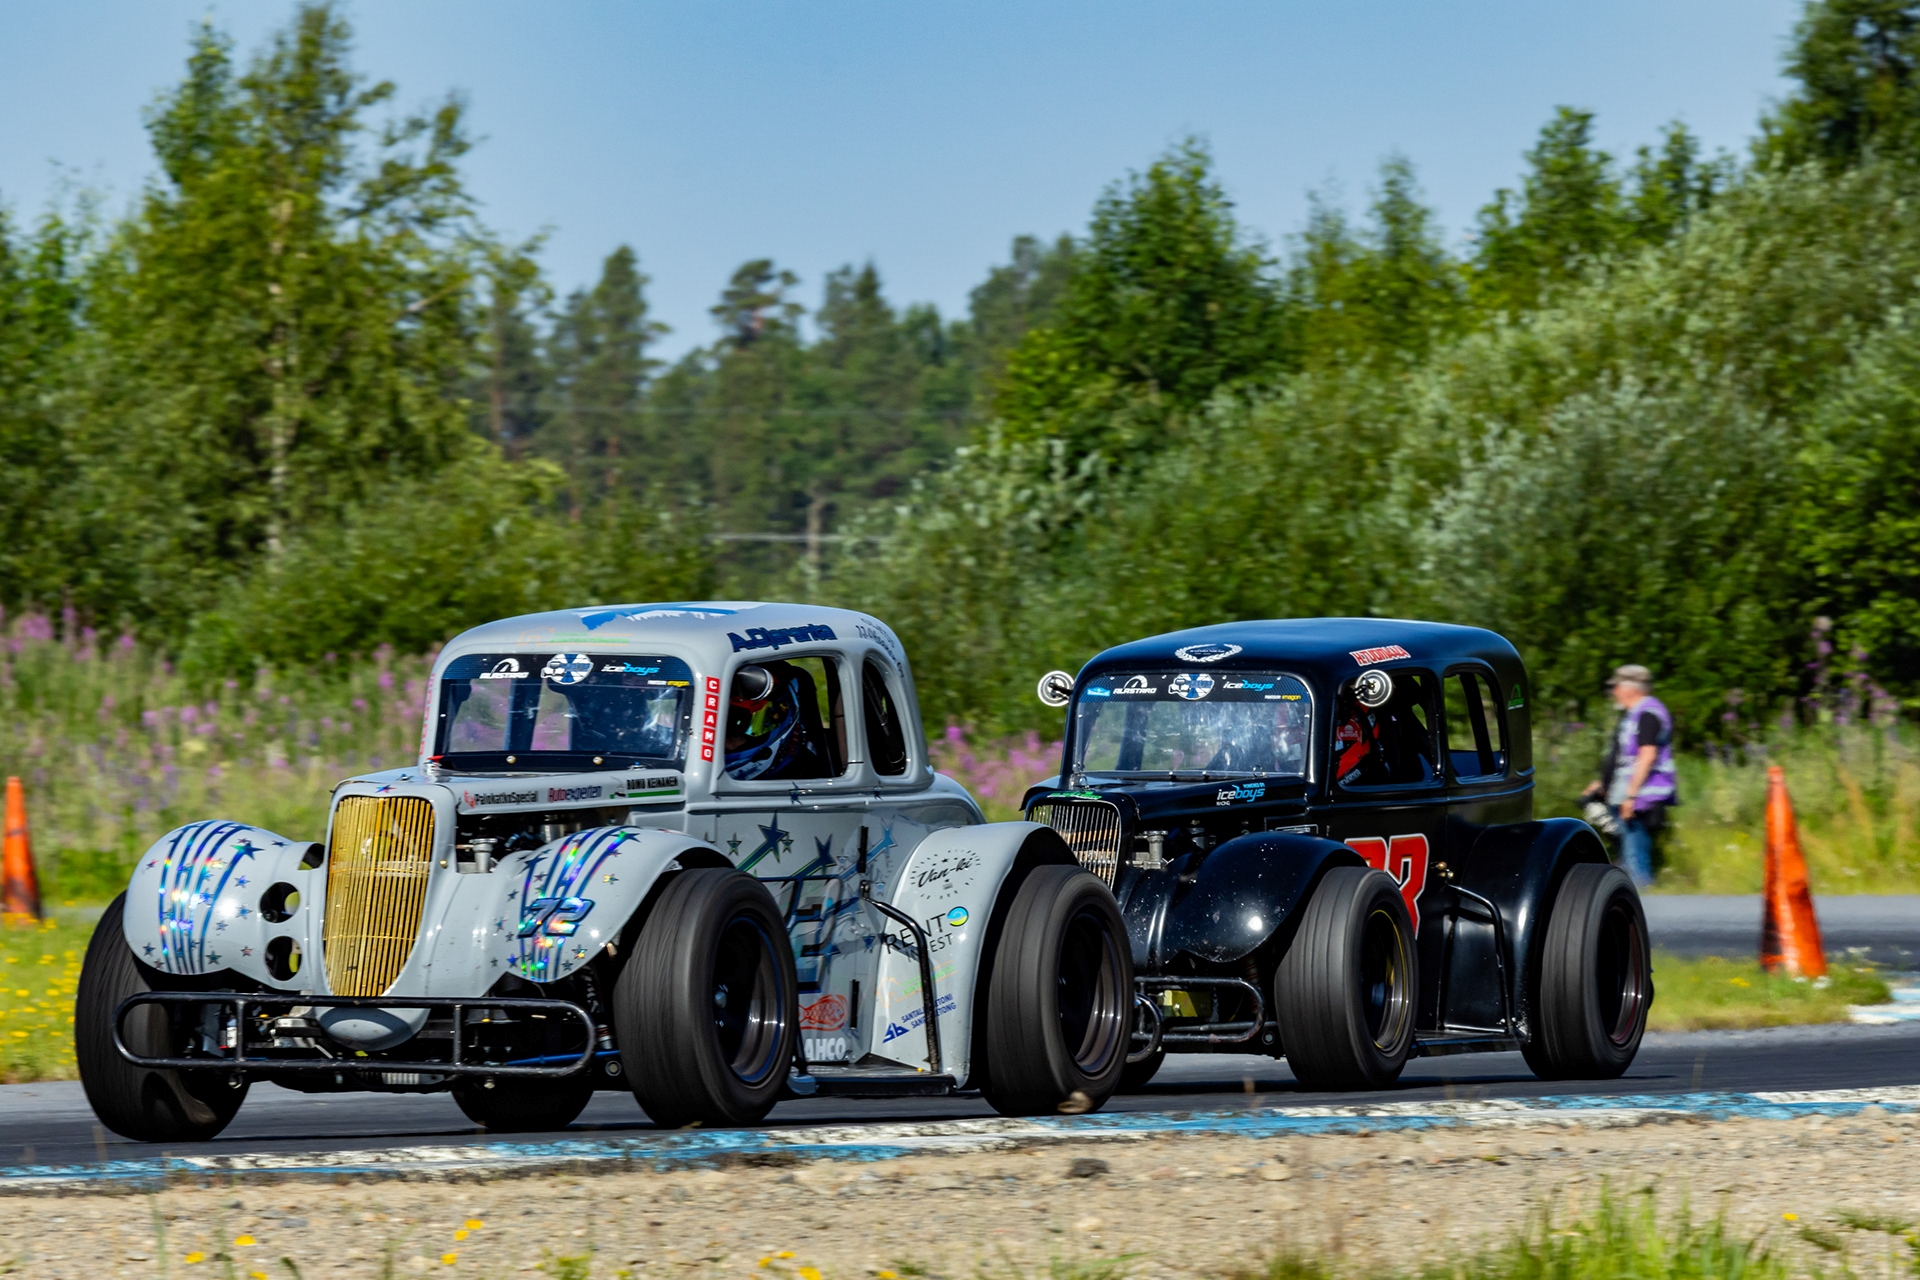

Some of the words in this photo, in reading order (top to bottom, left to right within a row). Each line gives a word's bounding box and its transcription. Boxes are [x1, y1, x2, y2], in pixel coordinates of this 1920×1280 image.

[601, 662, 660, 675] iceboys
[1223, 679, 1275, 692] iceboys
[702, 677, 719, 761] CRAMO
[1216, 784, 1266, 803] iceboys
[517, 897, 596, 939] 72
